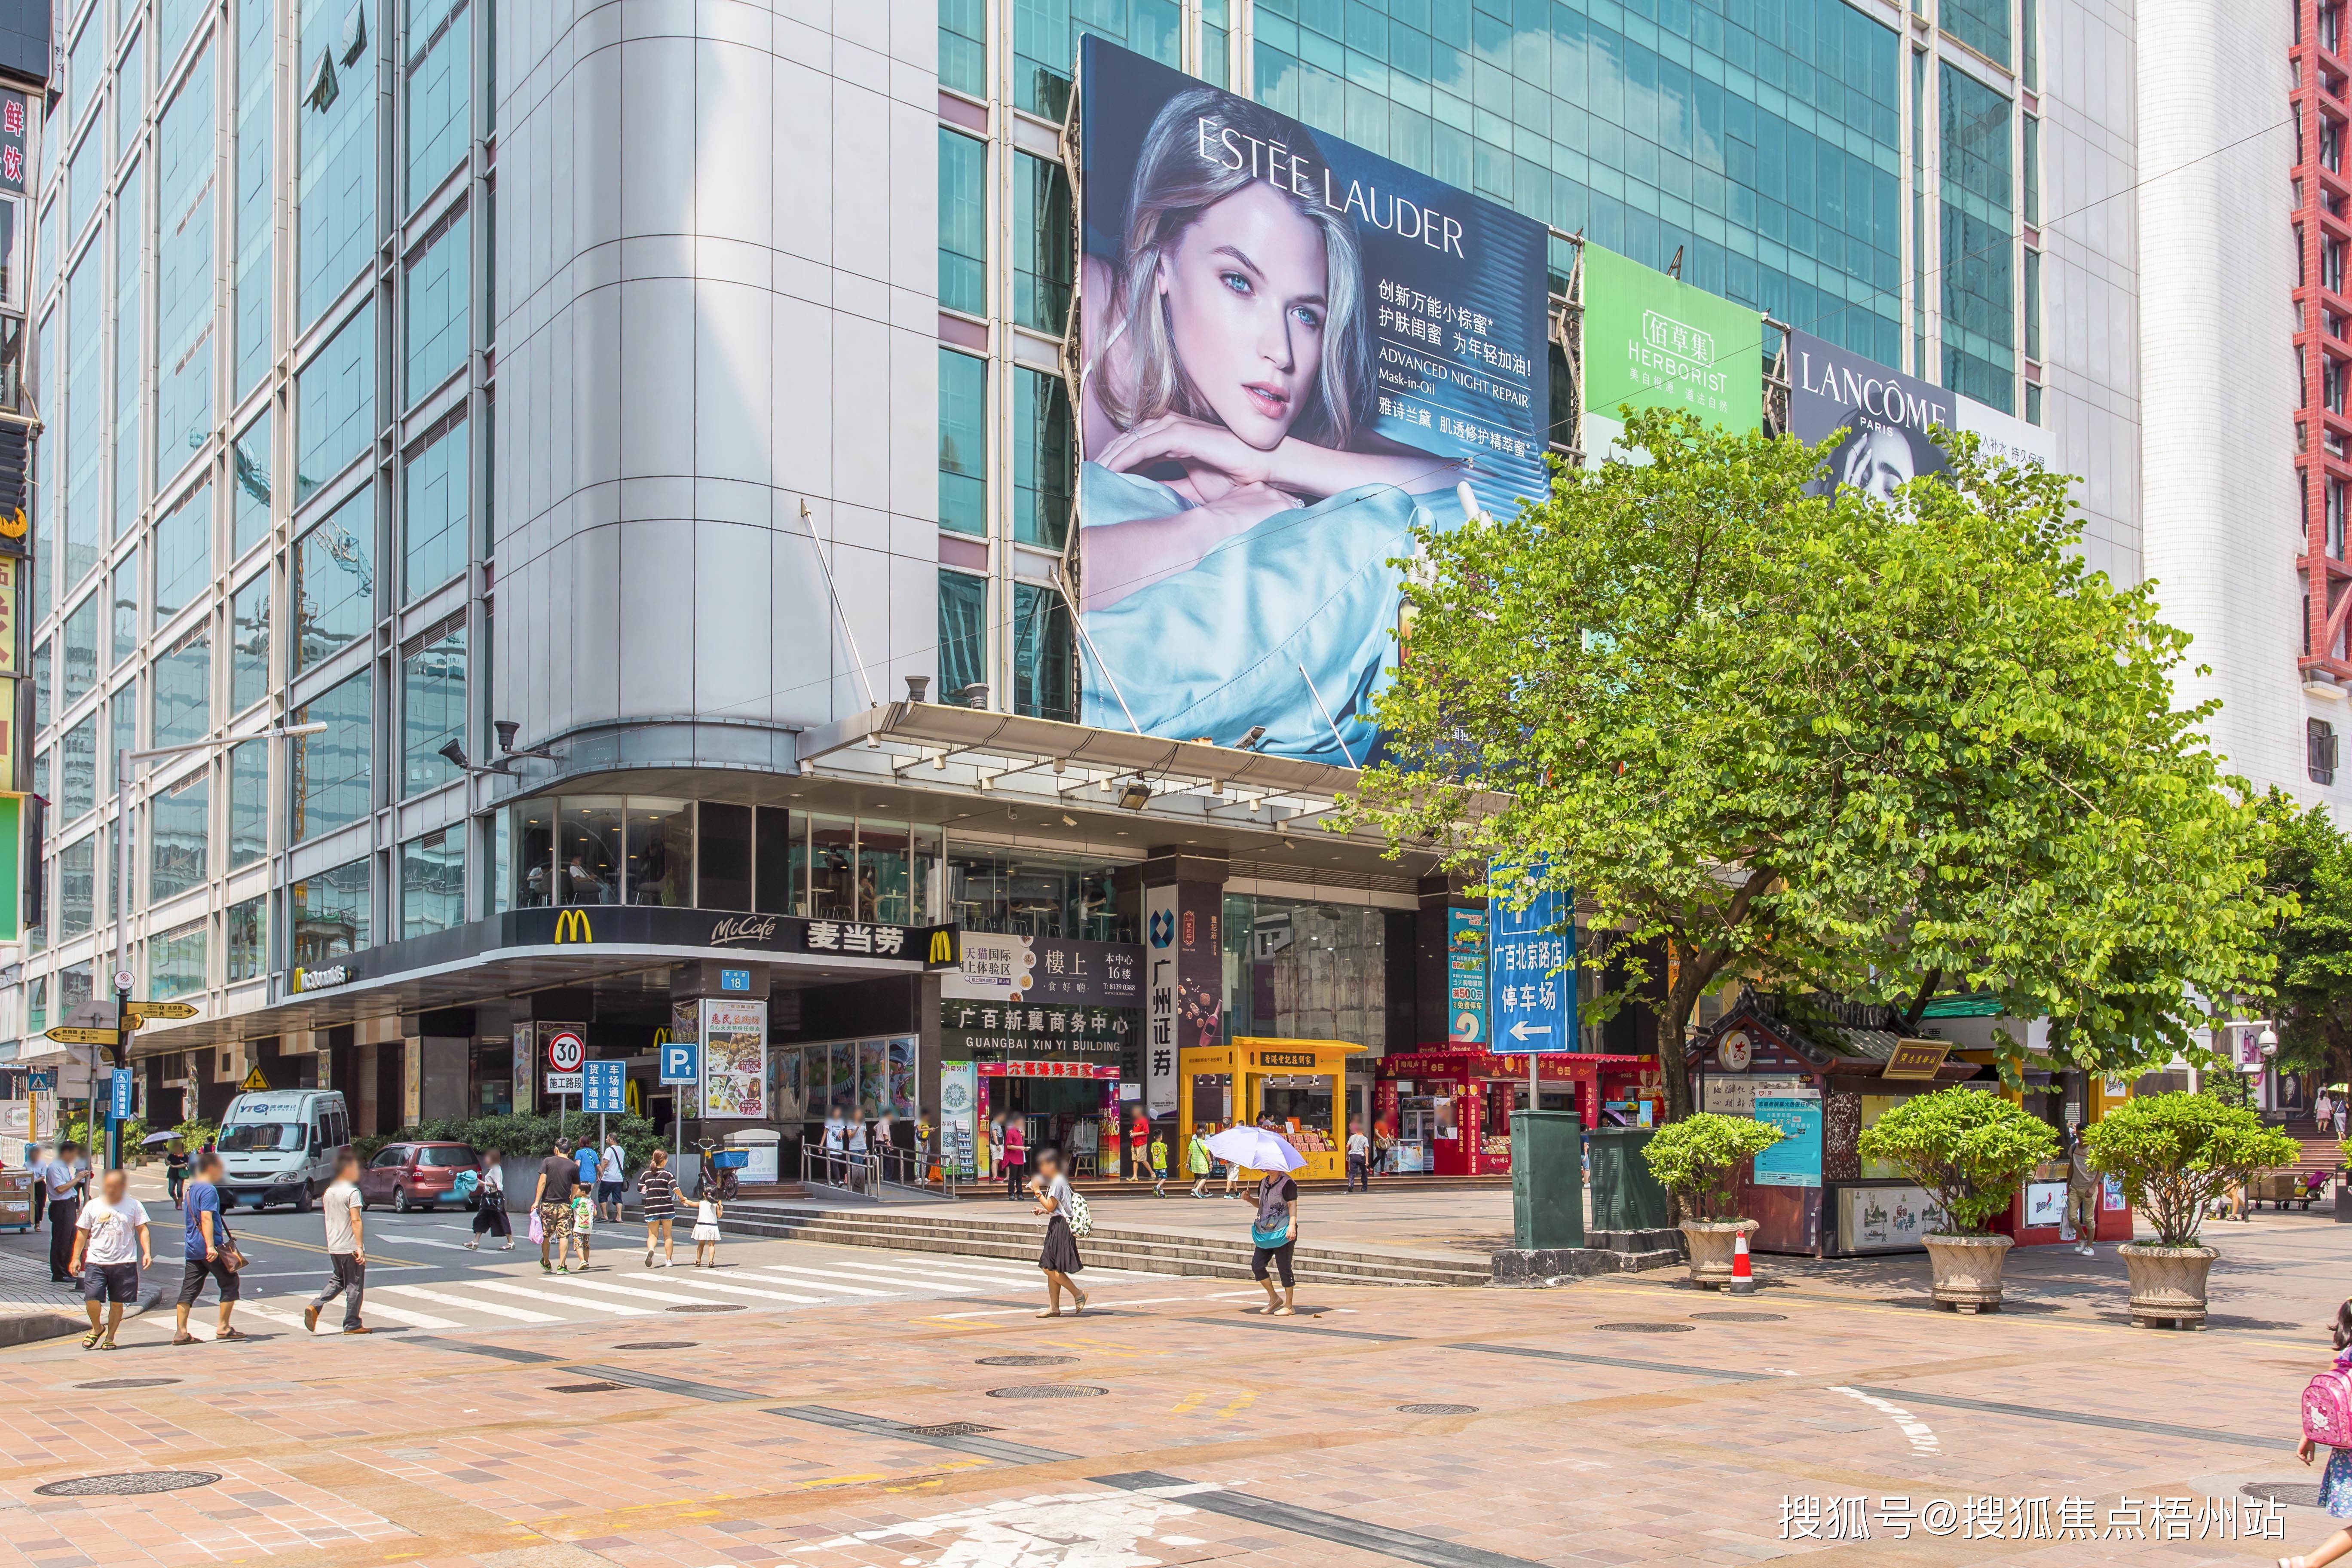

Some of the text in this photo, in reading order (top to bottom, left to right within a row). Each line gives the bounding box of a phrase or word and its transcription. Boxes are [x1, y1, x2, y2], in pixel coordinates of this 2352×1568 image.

[4, 99, 24, 137] 鲜
[3, 144, 23, 184] 饮
[1325, 168, 1464, 259] LAUDER
[1379, 305, 1442, 346] 护肤闺蜜
[1650, 316, 1708, 362] 佰草集
[1379, 346, 1528, 408] ADVANCED NIGHT REPAIR
[1379, 366, 1435, 395] Mask-in-Oil
[1629, 339, 1727, 394] HERBORIST
[1629, 367, 1728, 413] 美自根源 道法自然
[1801, 351, 1946, 435] LANCÔME
[1378, 396, 1432, 429] 雅诗兰黛
[1860, 416, 1893, 437] PARIS
[808, 921, 904, 955] 麦当劳
[965, 947, 1011, 962] 天猫国际
[1045, 949, 1088, 976] 樓上
[1105, 953, 1133, 965] 本中心
[1494, 940, 1562, 973] 广百北京路店
[731, 978, 741, 988] 18
[1108, 967, 1131, 980] 16 楼
[1453, 988, 1483, 1000] 满500元
[1453, 1001, 1482, 1010] 可免费停车
[1501, 981, 1556, 1014] 停车场
[959, 1008, 1129, 1035] 广百新翼商务中心
[1152, 959, 1172, 1077] 广州证券
[556, 1043, 577, 1061] 30
[966, 1037, 1120, 1052] GUANGBAI XIN YI BUILDING
[670, 1049, 689, 1074] P
[549, 1078, 582, 1089] 施工路段
[588, 1064, 599, 1109] 货车通道
[609, 1065, 619, 1109] 车场通道
